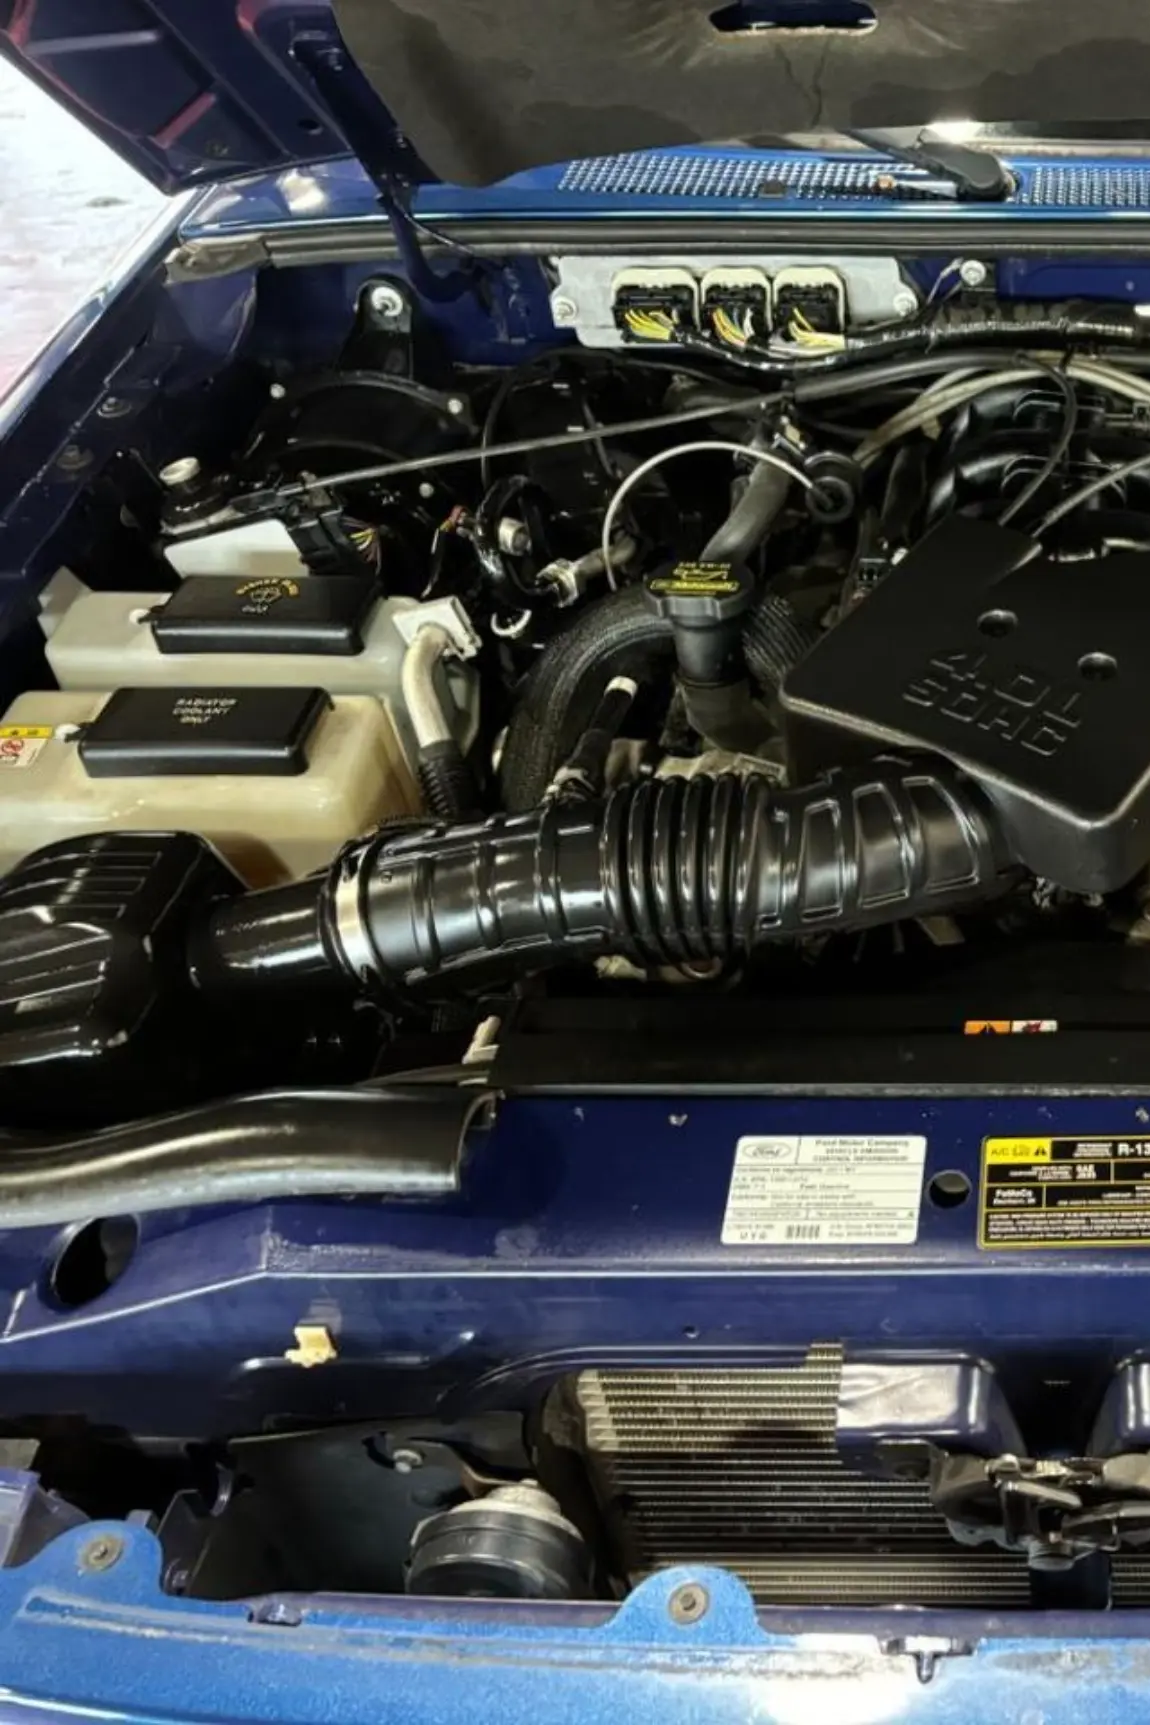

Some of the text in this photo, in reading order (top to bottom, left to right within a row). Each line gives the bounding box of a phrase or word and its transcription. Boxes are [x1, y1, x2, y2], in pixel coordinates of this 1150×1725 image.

[176, 697, 239, 708] RADIATOR
[172, 707, 232, 716] COOLANT
[180, 715, 212, 725] ONLY
